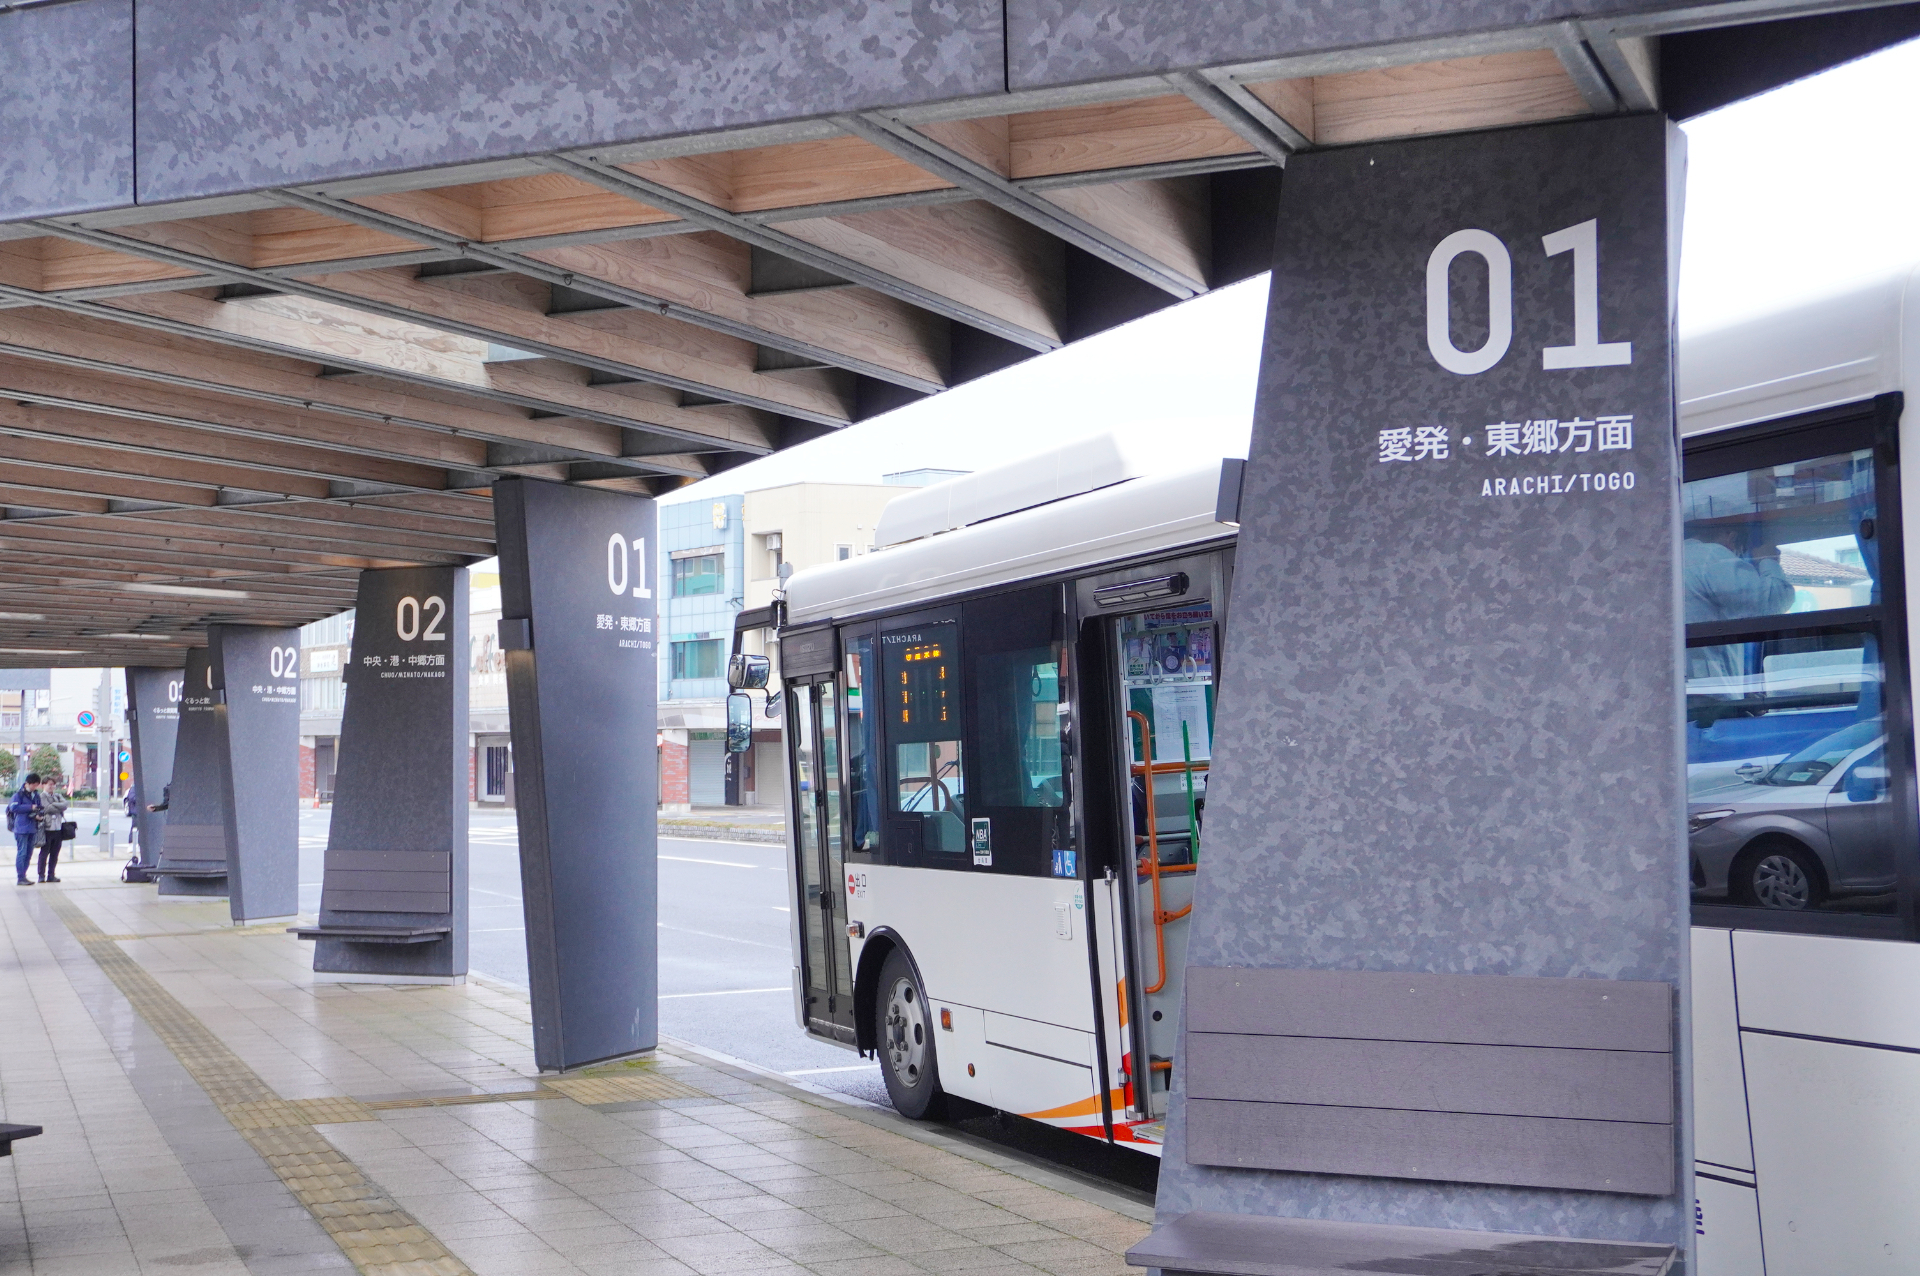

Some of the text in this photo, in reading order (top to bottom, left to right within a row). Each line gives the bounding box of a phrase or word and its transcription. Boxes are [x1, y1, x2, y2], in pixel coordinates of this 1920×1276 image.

[1426, 217, 1632, 375] 01
[1378, 414, 1634, 463] 愛発・東郷方面
[1481, 471, 1636, 497] ARACHI/TOGO
[607, 532, 652, 599] 01
[396, 595, 446, 641] 02
[596, 613, 652, 634] 愛発・東郷方面
[618, 639, 652, 650] ARACHI/TOGO
[270, 646, 297, 678] 02
[363, 654, 446, 667] 中央・港・中郷方面
[854, 872, 867, 888] 出口
